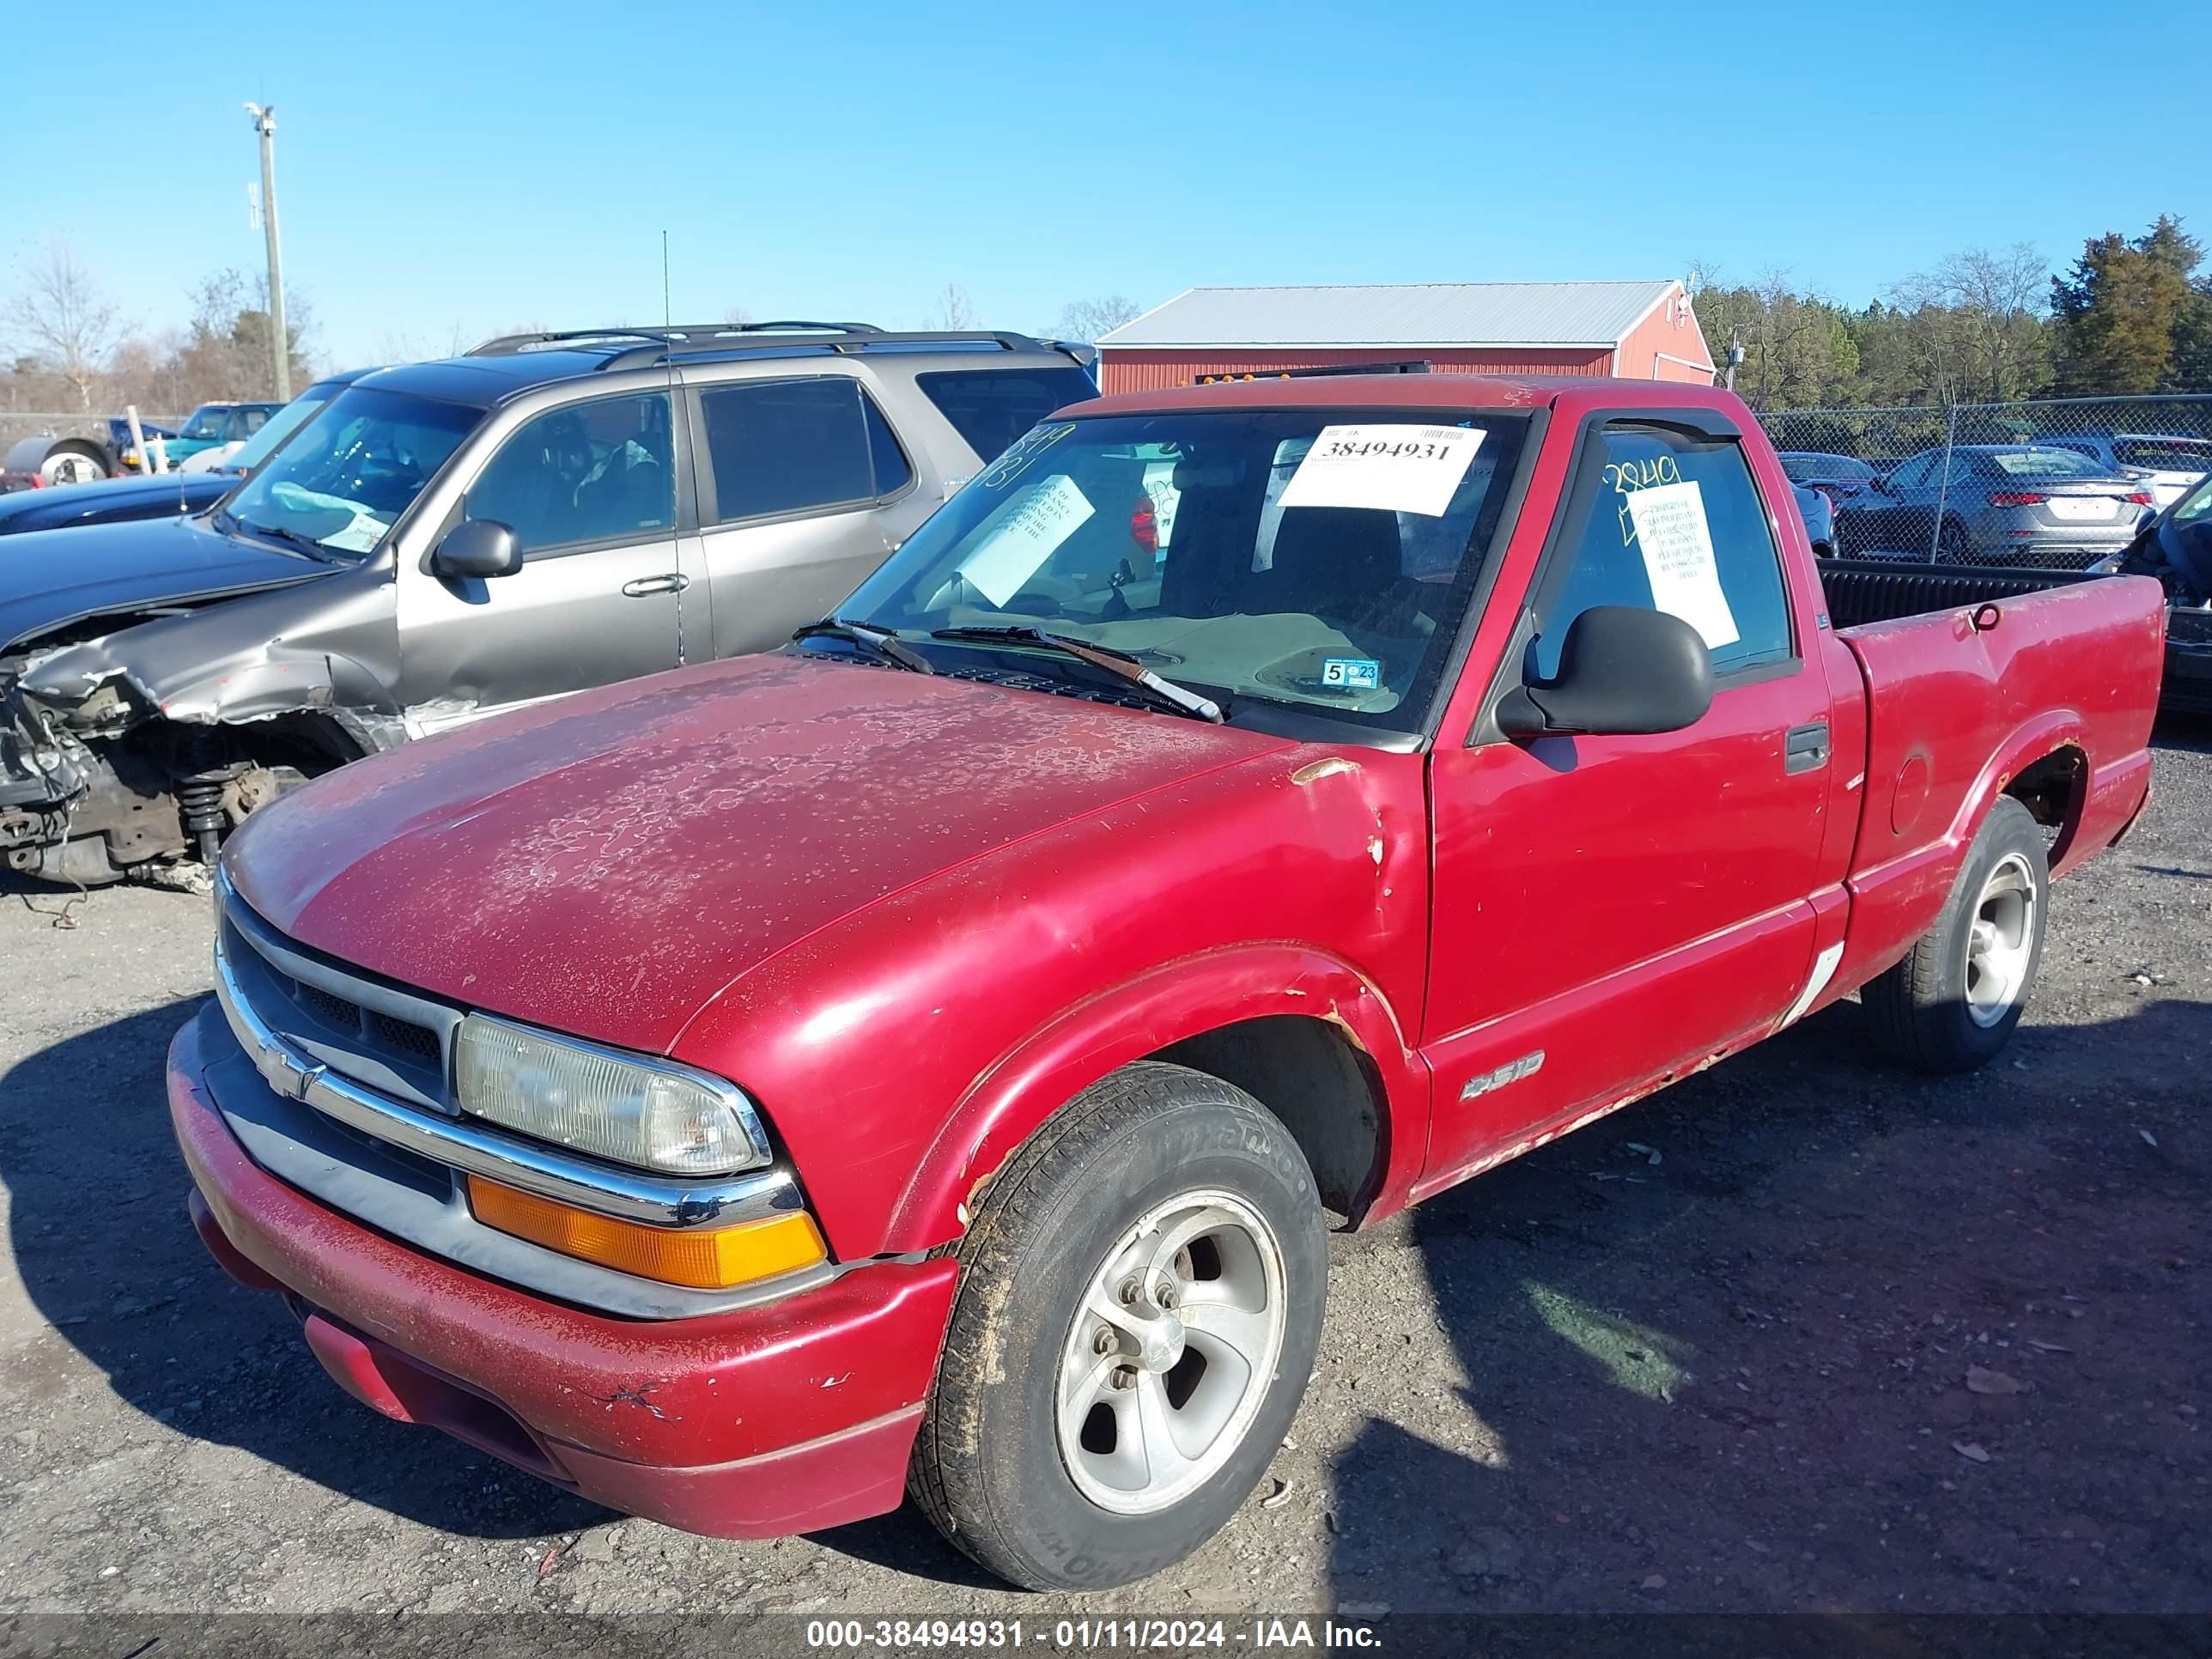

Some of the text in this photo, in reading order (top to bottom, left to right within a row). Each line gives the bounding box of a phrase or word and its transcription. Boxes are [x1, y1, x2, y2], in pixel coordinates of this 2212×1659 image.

[1322, 441, 1449, 460] 38494931
[1328, 665, 1376, 680] 5 23
